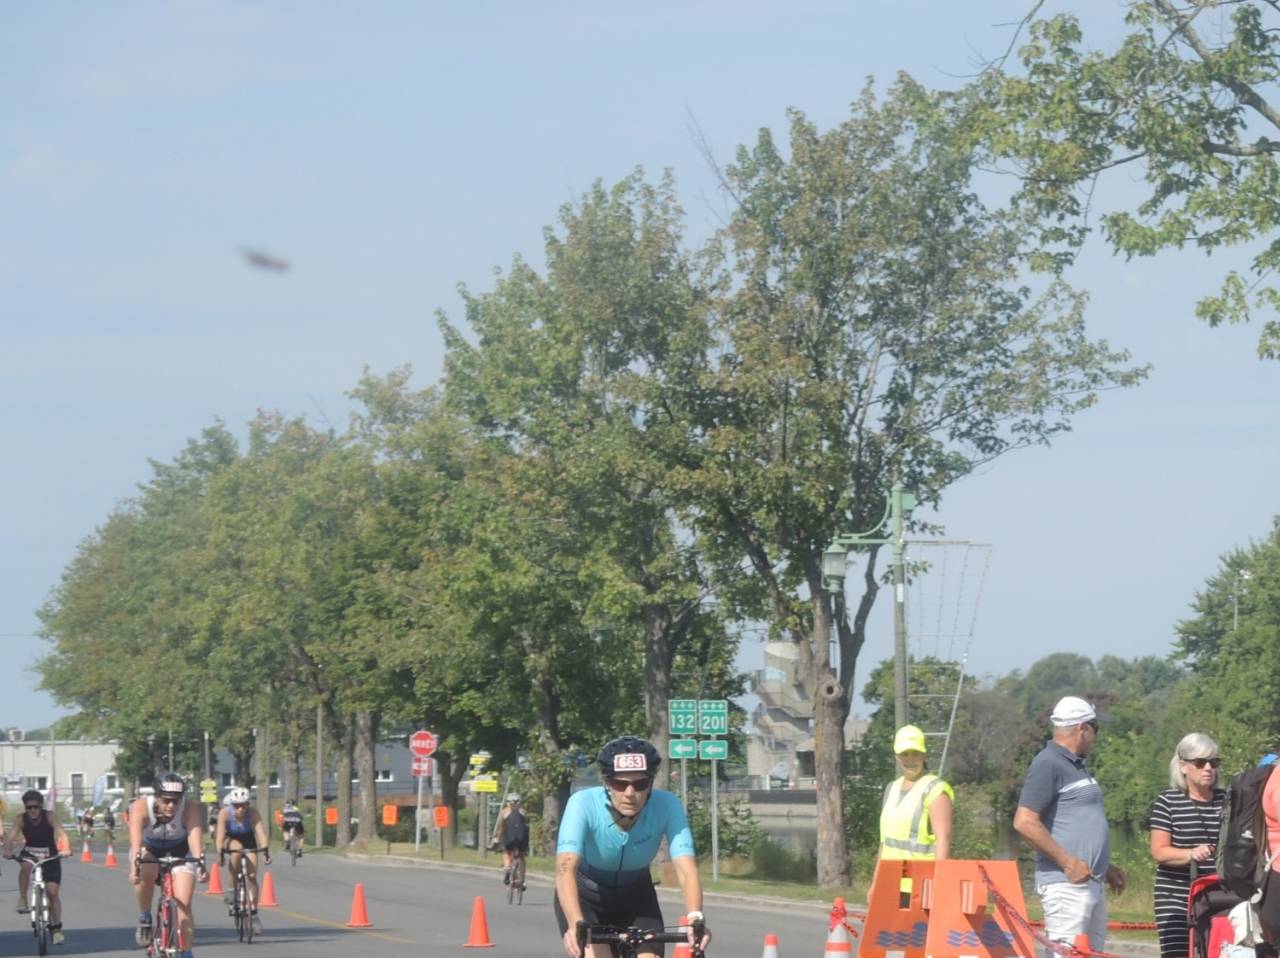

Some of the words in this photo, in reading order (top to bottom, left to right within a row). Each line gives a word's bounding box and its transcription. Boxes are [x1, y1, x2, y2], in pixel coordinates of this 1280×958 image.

[672, 714, 694, 728] 132
[703, 716, 724, 729] 201
[619, 756, 642, 768] 663
